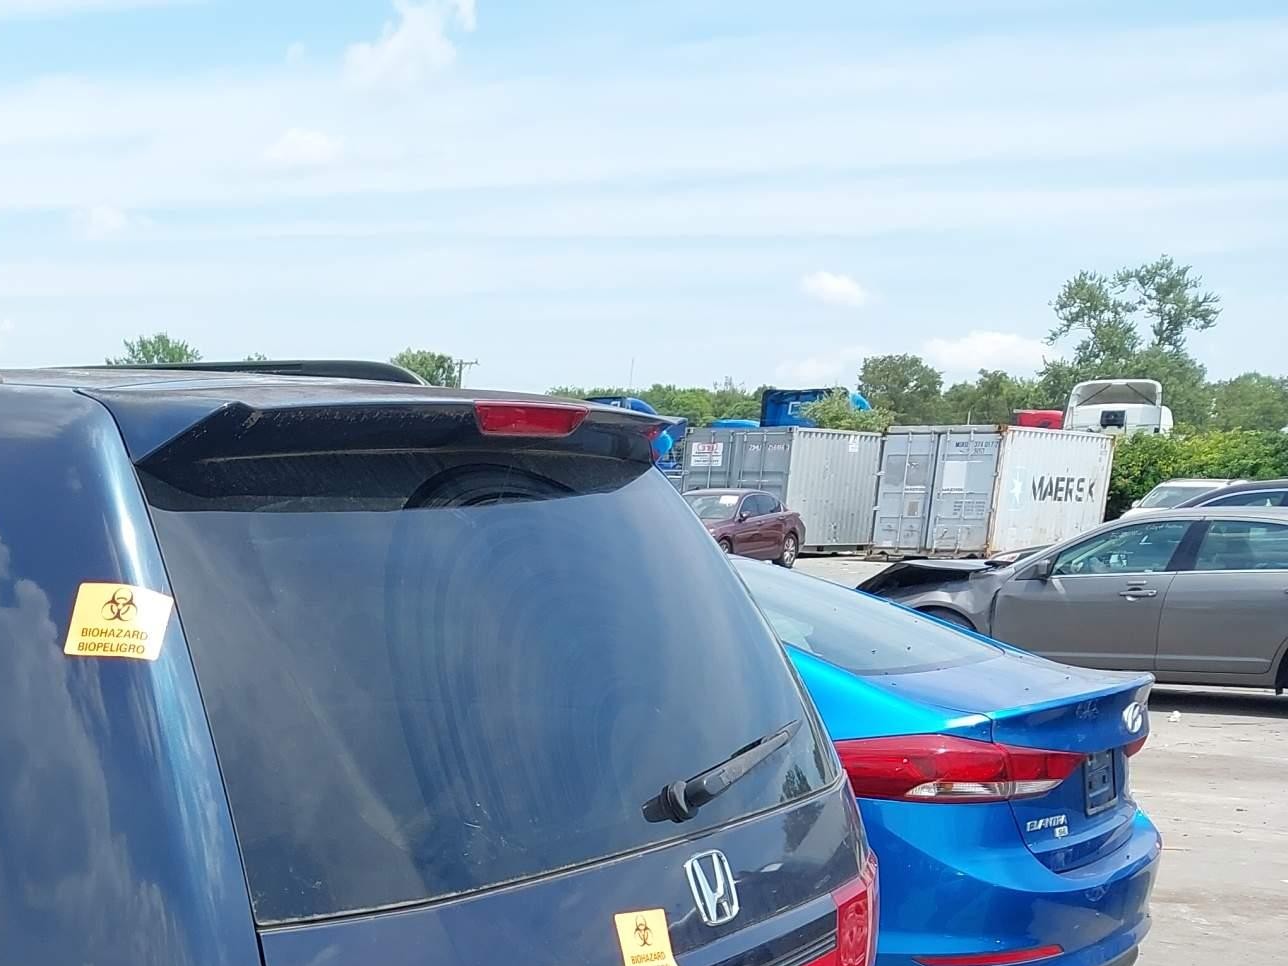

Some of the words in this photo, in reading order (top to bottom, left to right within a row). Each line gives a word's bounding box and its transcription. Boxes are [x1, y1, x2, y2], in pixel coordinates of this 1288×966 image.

[1032, 475, 1096, 503] MAERSK
[81, 627, 148, 641] BIOHAZARD
[77, 641, 145, 654] BIOPELIGRO
